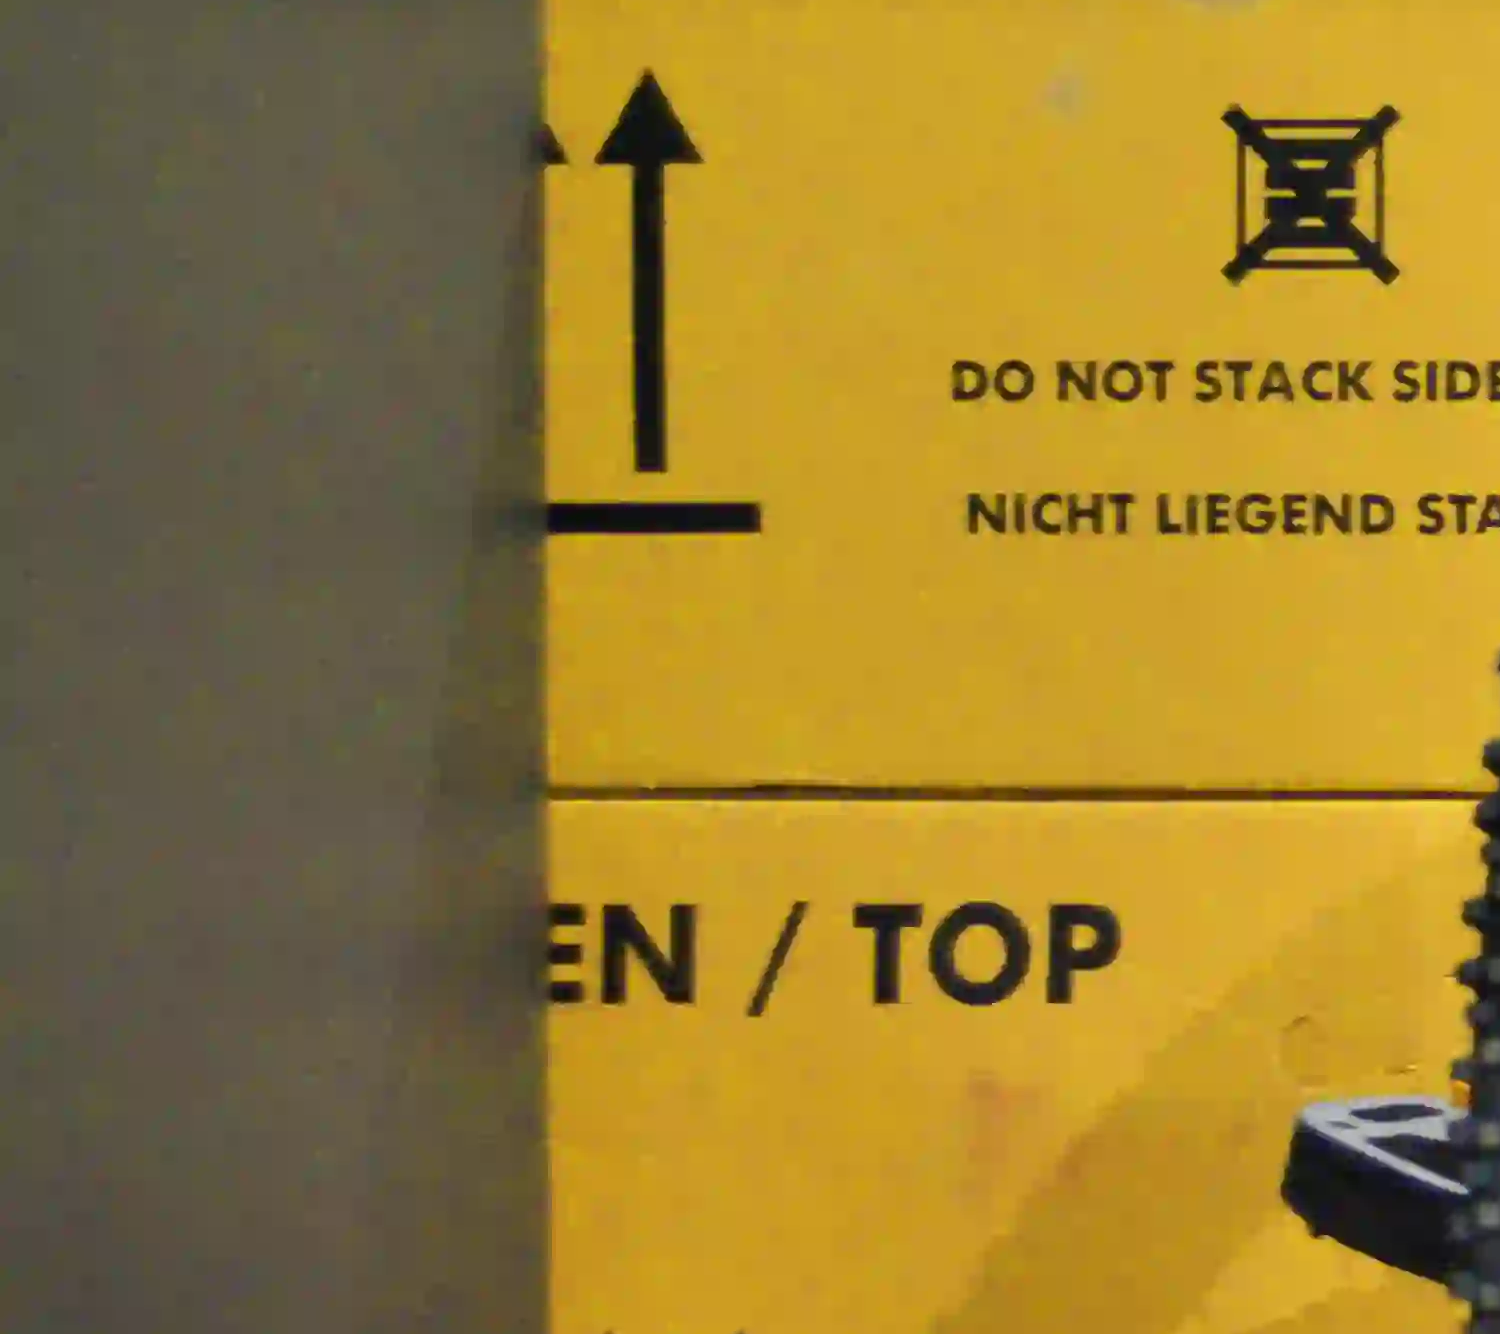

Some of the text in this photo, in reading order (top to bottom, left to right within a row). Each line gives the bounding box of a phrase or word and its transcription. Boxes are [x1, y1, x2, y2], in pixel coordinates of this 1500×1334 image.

[951, 359, 1036, 403] DO
[1057, 360, 1176, 404] NOT
[1195, 360, 1375, 404] STACK
[967, 492, 1136, 535] NICHT
[1156, 492, 1396, 535] LIEGEND
[747, 901, 808, 1017] /
[853, 902, 1121, 1007] TOP
